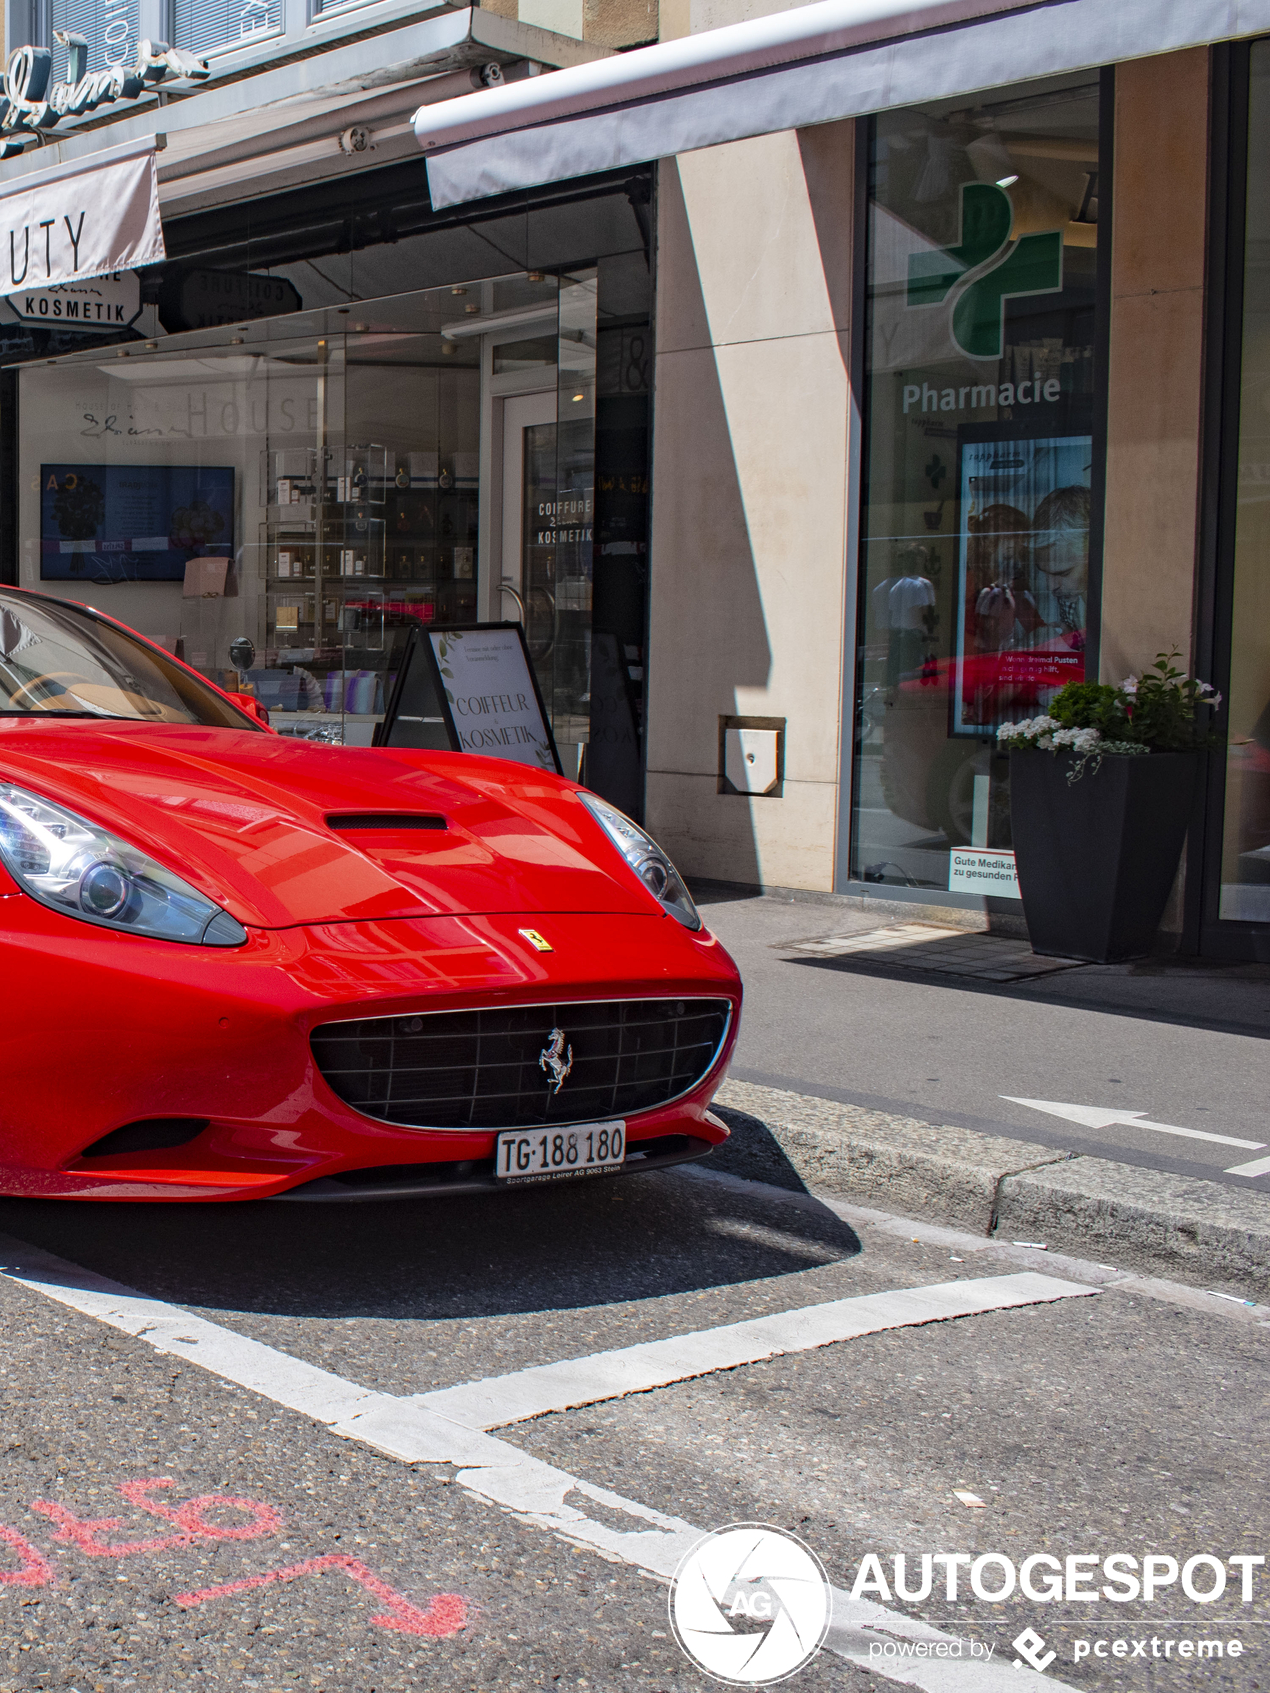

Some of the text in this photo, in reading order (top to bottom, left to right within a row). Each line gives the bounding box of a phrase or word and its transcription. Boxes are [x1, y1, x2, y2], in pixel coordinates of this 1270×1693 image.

[104, 0, 129, 66] COI
[25, 296, 124, 322] KOSMETIK
[902, 371, 1061, 414] Pharmacie
[538, 499, 591, 516] COIFFURE
[538, 528, 593, 544] KOSMETIK
[1054, 656, 1079, 664] Pusten
[456, 693, 530, 716] COIFFEUR
[458, 725, 538, 750] KOSMETIK
[954, 856, 977, 867] Gute
[953, 868, 964, 876] zu
[965, 869, 1012, 881] gesunden
[585, 1127, 623, 1163] 180
[573, 1169, 585, 1177] AG
[603, 1164, 621, 1174] Stein
